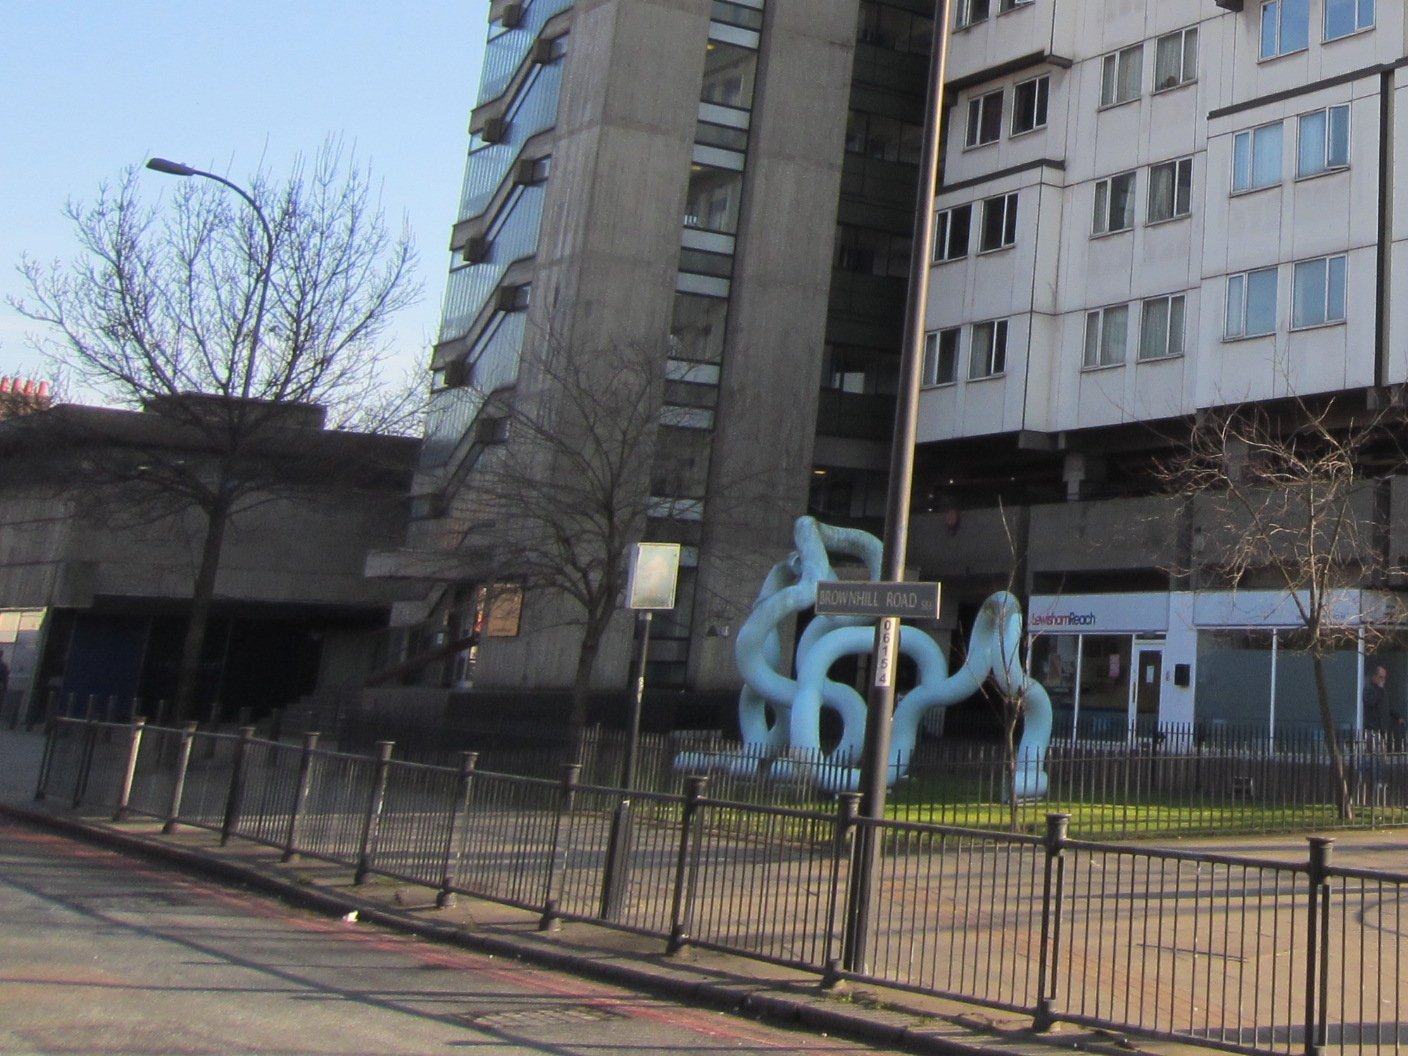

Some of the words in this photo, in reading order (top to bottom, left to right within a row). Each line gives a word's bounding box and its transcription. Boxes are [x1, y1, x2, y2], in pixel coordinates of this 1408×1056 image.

[819, 590, 879, 607] BROWNHILL
[886, 591, 918, 608] ROAD
[879, 620, 892, 683] 06154
